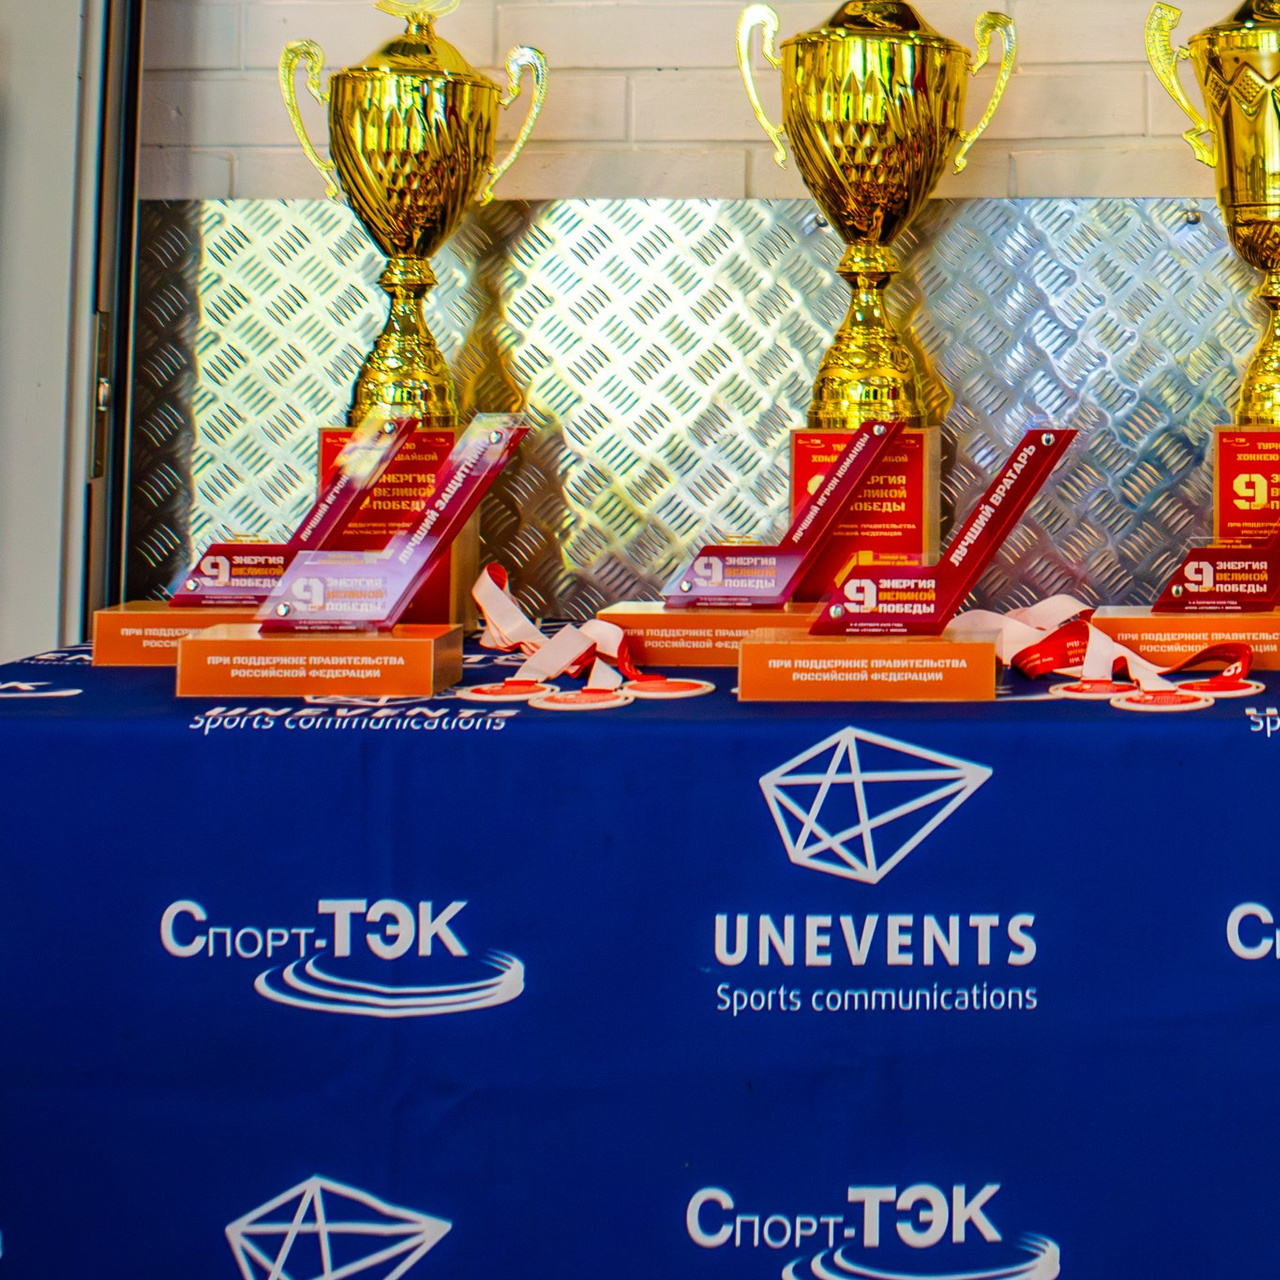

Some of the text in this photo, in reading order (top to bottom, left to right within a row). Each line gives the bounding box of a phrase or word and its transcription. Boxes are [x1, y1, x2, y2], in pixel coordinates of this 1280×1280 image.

[380, 473, 436, 484] НЕРГИЯ
[792, 504, 821, 544] ЛУЧШИЙ
[816, 475, 841, 507] ИГРОК
[835, 433, 871, 479] КОМАНДЫ
[1232, 473, 1268, 510] 9
[950, 444, 1037, 567] ЛУЧШИЙ ВРАТАРЬ
[399, 508, 440, 565] ЛУЧШИЙ
[1216, 560, 1268, 570] ЭНЕРГИЯ
[1183, 560, 1215, 593] 9
[1215, 570, 1269, 582] ВЕЛИКОЙ
[878, 578, 937, 589] ЭНЕРГИЯ
[1215, 583, 1268, 594] ПОБЕДЫ
[843, 578, 878, 613] 9
[878, 589, 937, 601] ВЕЛИКОЙ
[878, 602, 936, 615] ПОБЕДЫ
[645, 628, 714, 638] ПОДДЕРЖКЕ
[1116, 632, 1140, 641] ПРИ
[1140, 631, 1209, 642] ПОДДЕРЖКЕ
[643, 638, 714, 650] РОССИЙСКОЙ
[207, 655, 406, 666] ПРИ ПОДДЕРЖКЕ ПРАВИТЕЛЬСТВА
[768, 658, 969, 670] ПРИ ПОДДЕРЖКЕ ПРАВИТЕЛЬСТВА
[230, 667, 382, 679] РОССИЙСКОЙ ФЕДЕРАЦИИ
[791, 670, 945, 683] РОССИЙСКОЙ ФЕДЕРАЦИИ
[713, 913, 1038, 968] UNEVENTS
[715, 980, 1039, 1017] Sports communications
